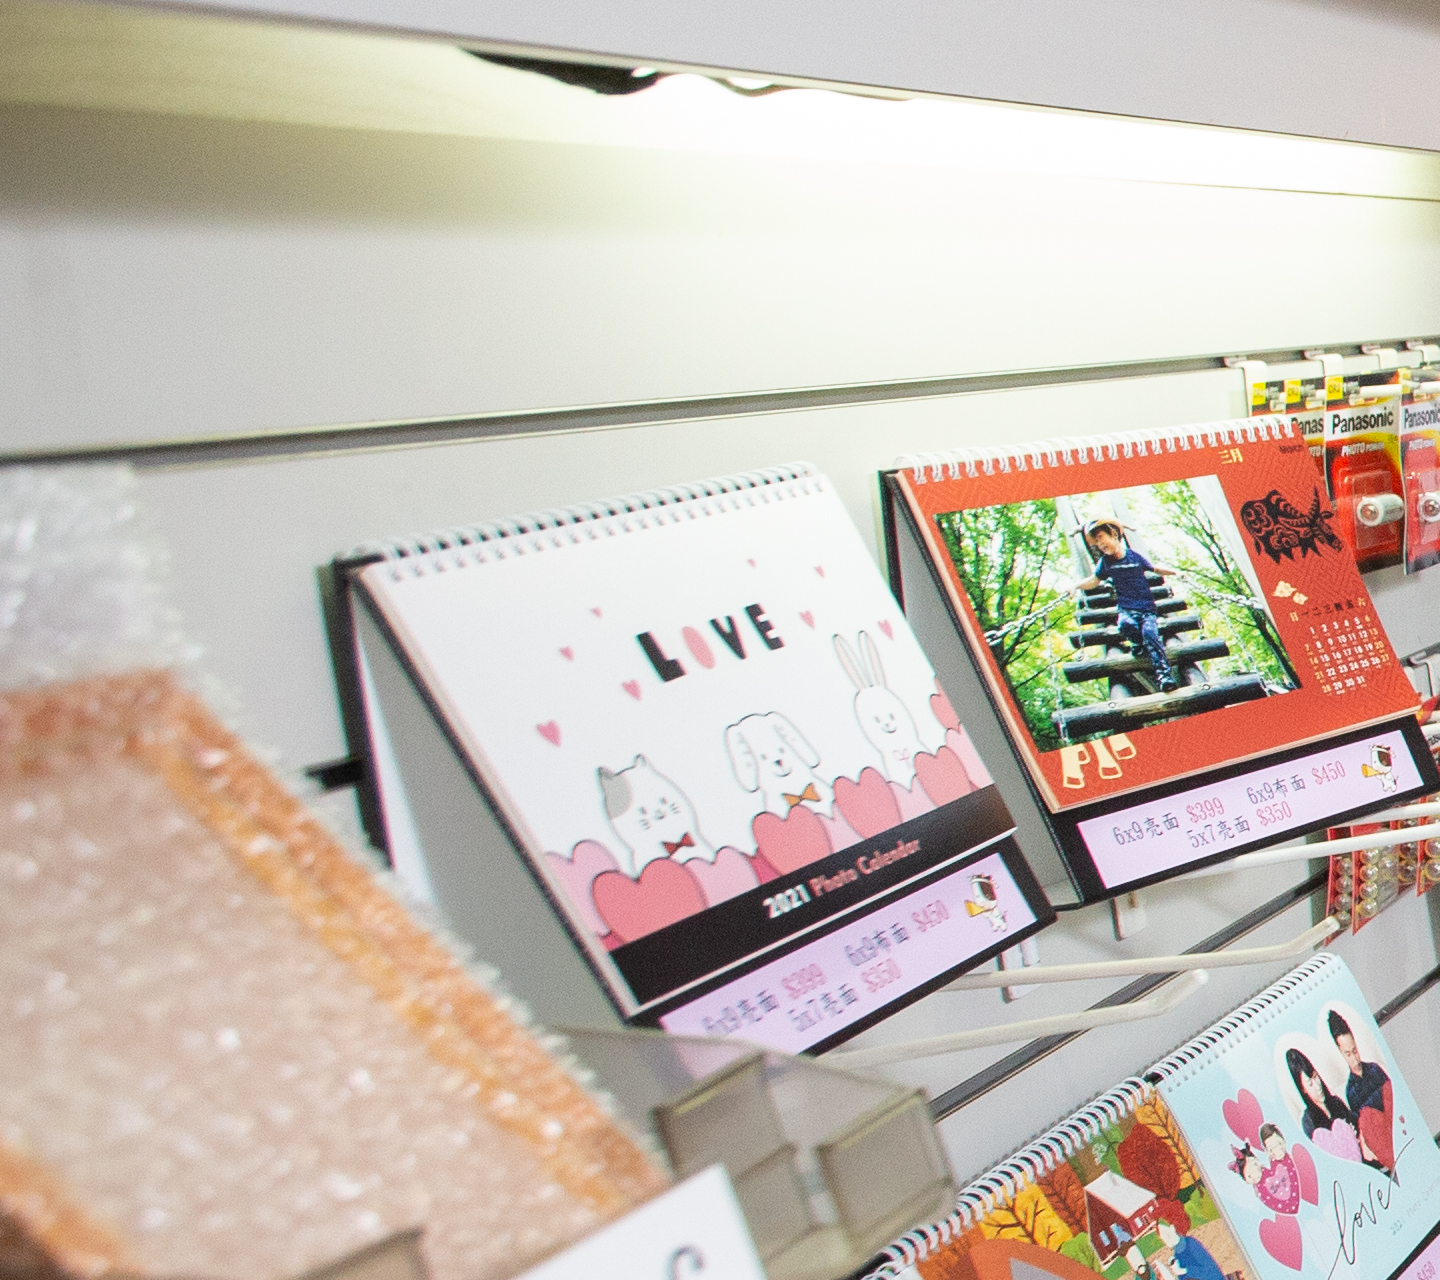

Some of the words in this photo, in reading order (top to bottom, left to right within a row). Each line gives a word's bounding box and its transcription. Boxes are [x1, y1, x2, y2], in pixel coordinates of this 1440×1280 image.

[1332, 406, 1394, 435] Panasonic
[1218, 448, 1244, 465] 三月
[1341, 443, 1365, 457] PHOTO
[634, 602, 787, 684] LOVE
[1111, 812, 1180, 847] 6x9亮面
[1185, 797, 1226, 825] $399
[1245, 774, 1307, 806] 6x9布面
[1310, 759, 1347, 787] $450
[1185, 815, 1252, 849] 5x7亮面
[1255, 800, 1294, 828] $350
[762, 884, 812, 919] 2021
